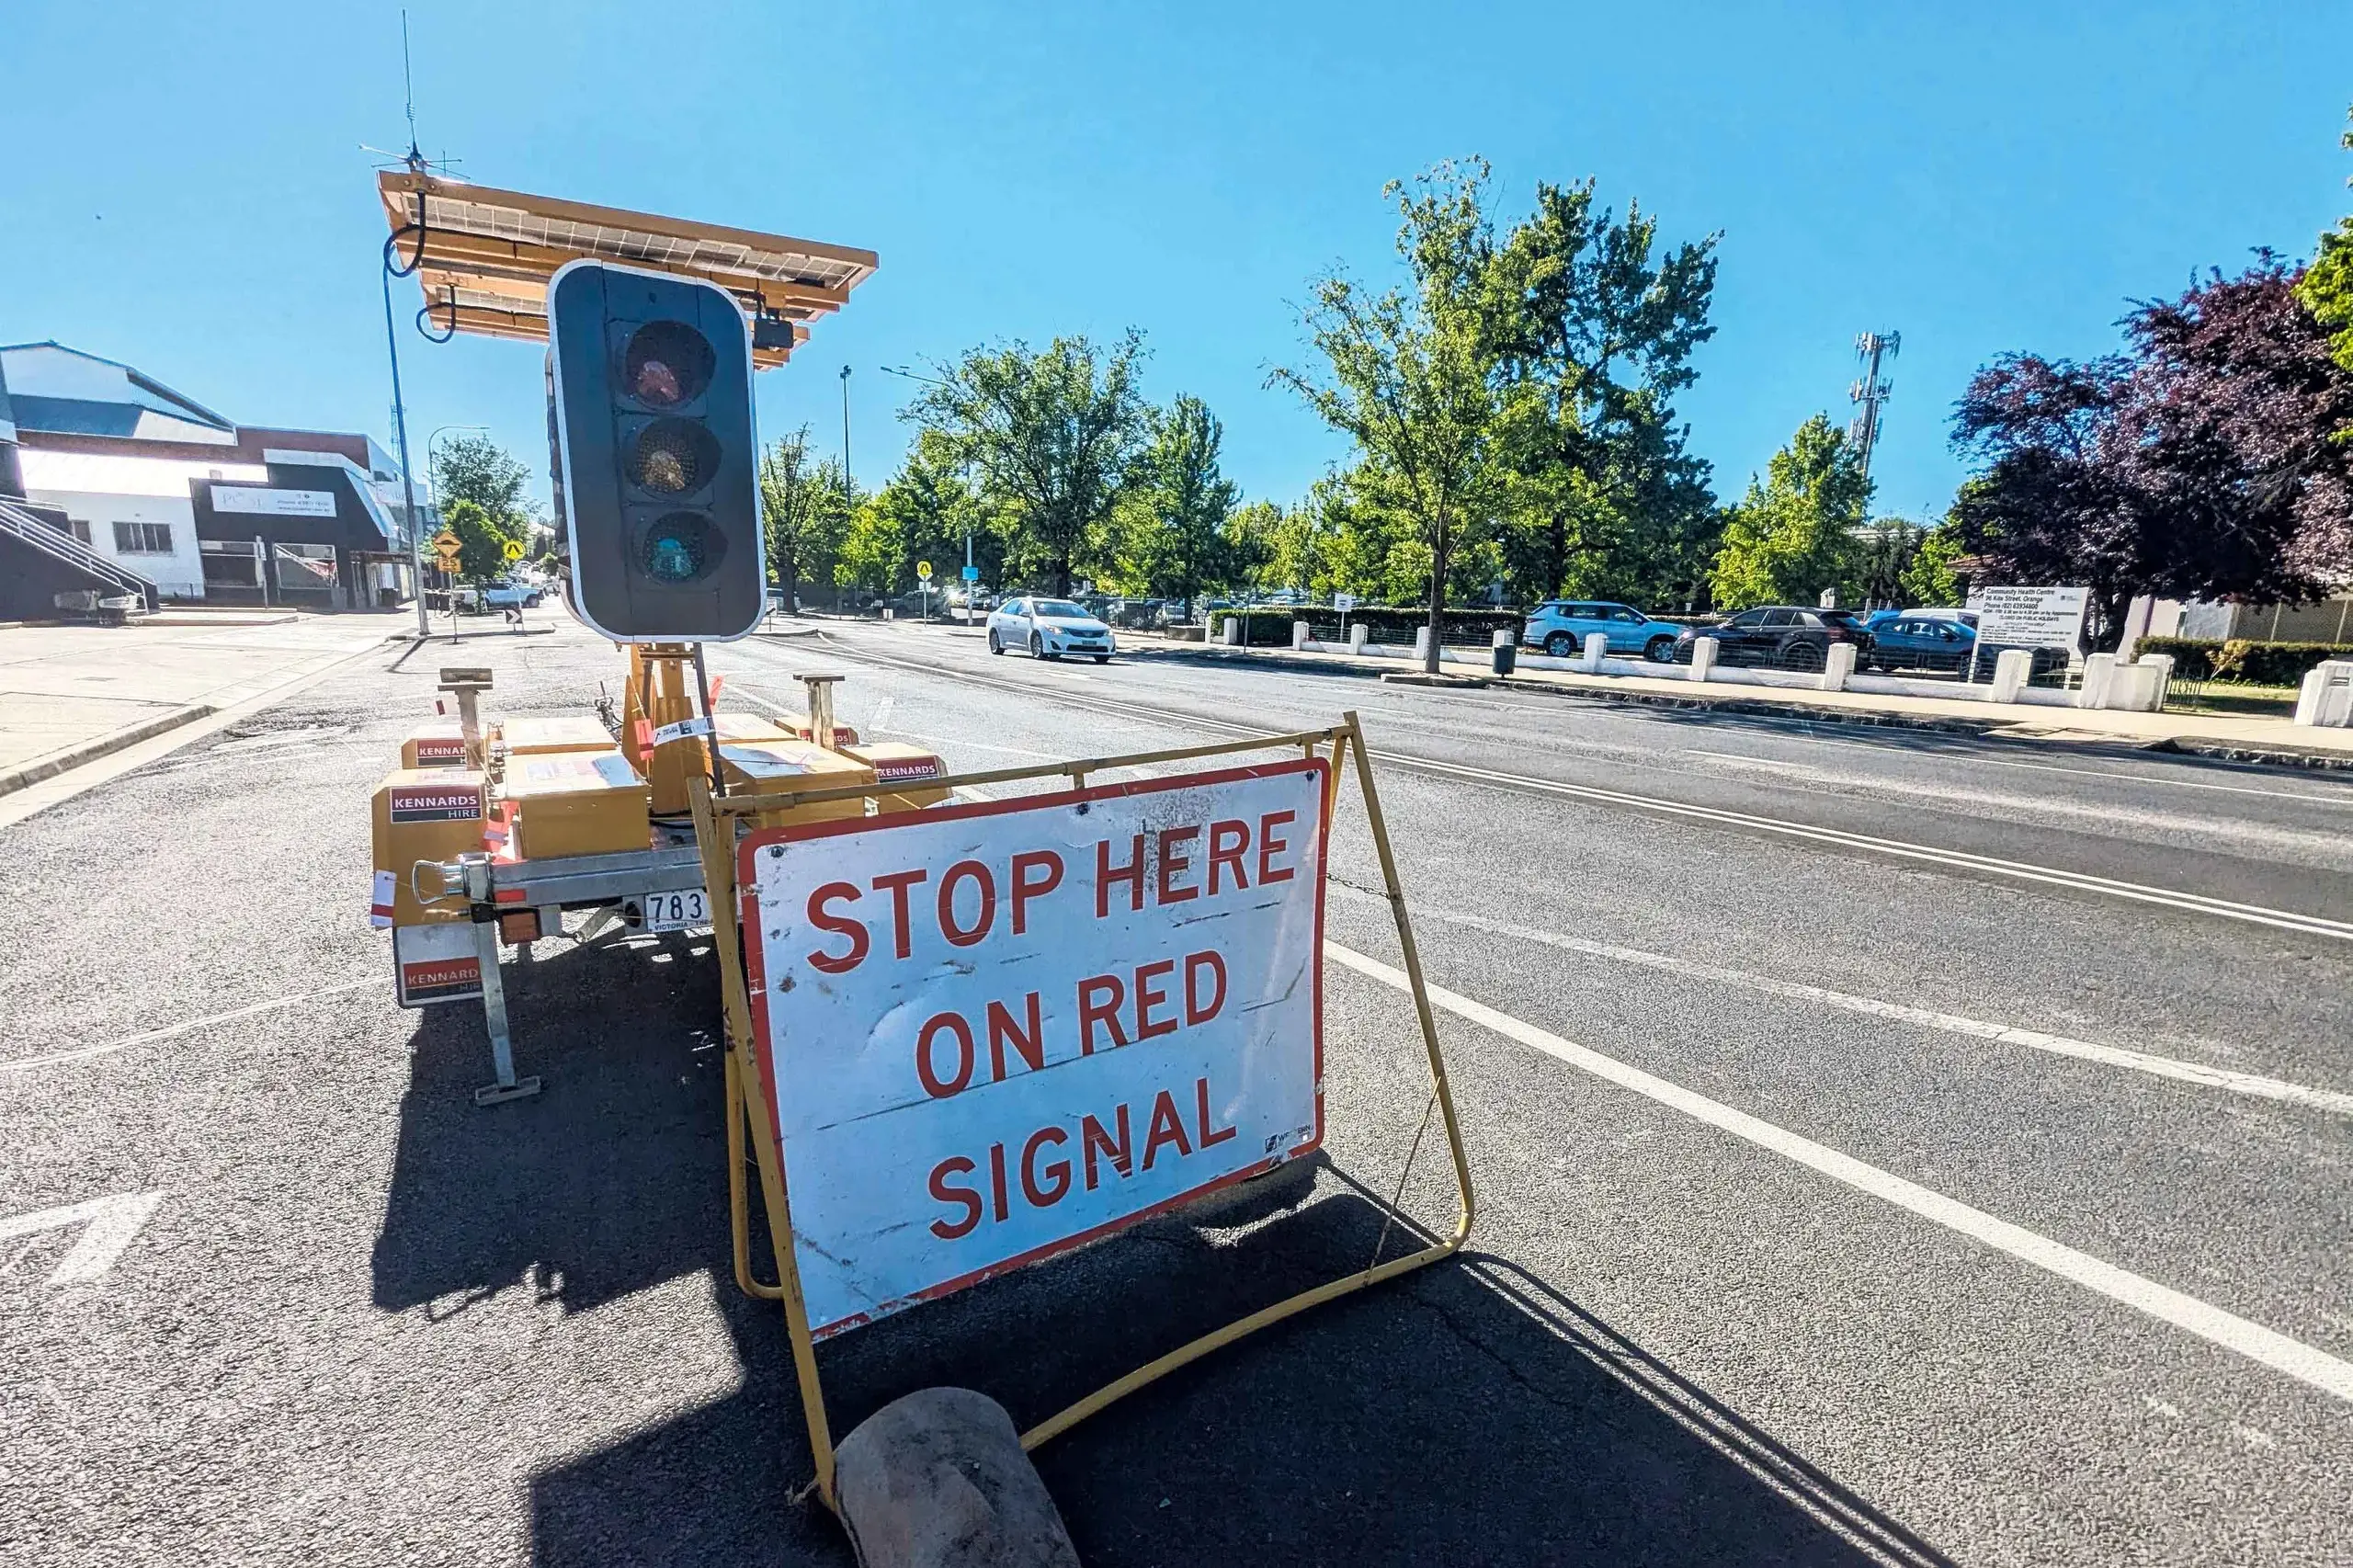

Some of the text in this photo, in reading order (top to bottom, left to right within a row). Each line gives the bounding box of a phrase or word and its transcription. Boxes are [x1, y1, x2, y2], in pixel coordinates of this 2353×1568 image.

[880, 765, 936, 777] KENNARDS
[395, 795, 477, 809] KENNARDS
[448, 809, 478, 819] HIRE
[806, 809, 1296, 974] STOP HERE
[654, 921, 688, 931] VICTORIA
[408, 968, 479, 985] KENNARD
[915, 949, 1228, 1098] ON RED
[927, 1077, 1237, 1241] SIGNAL
